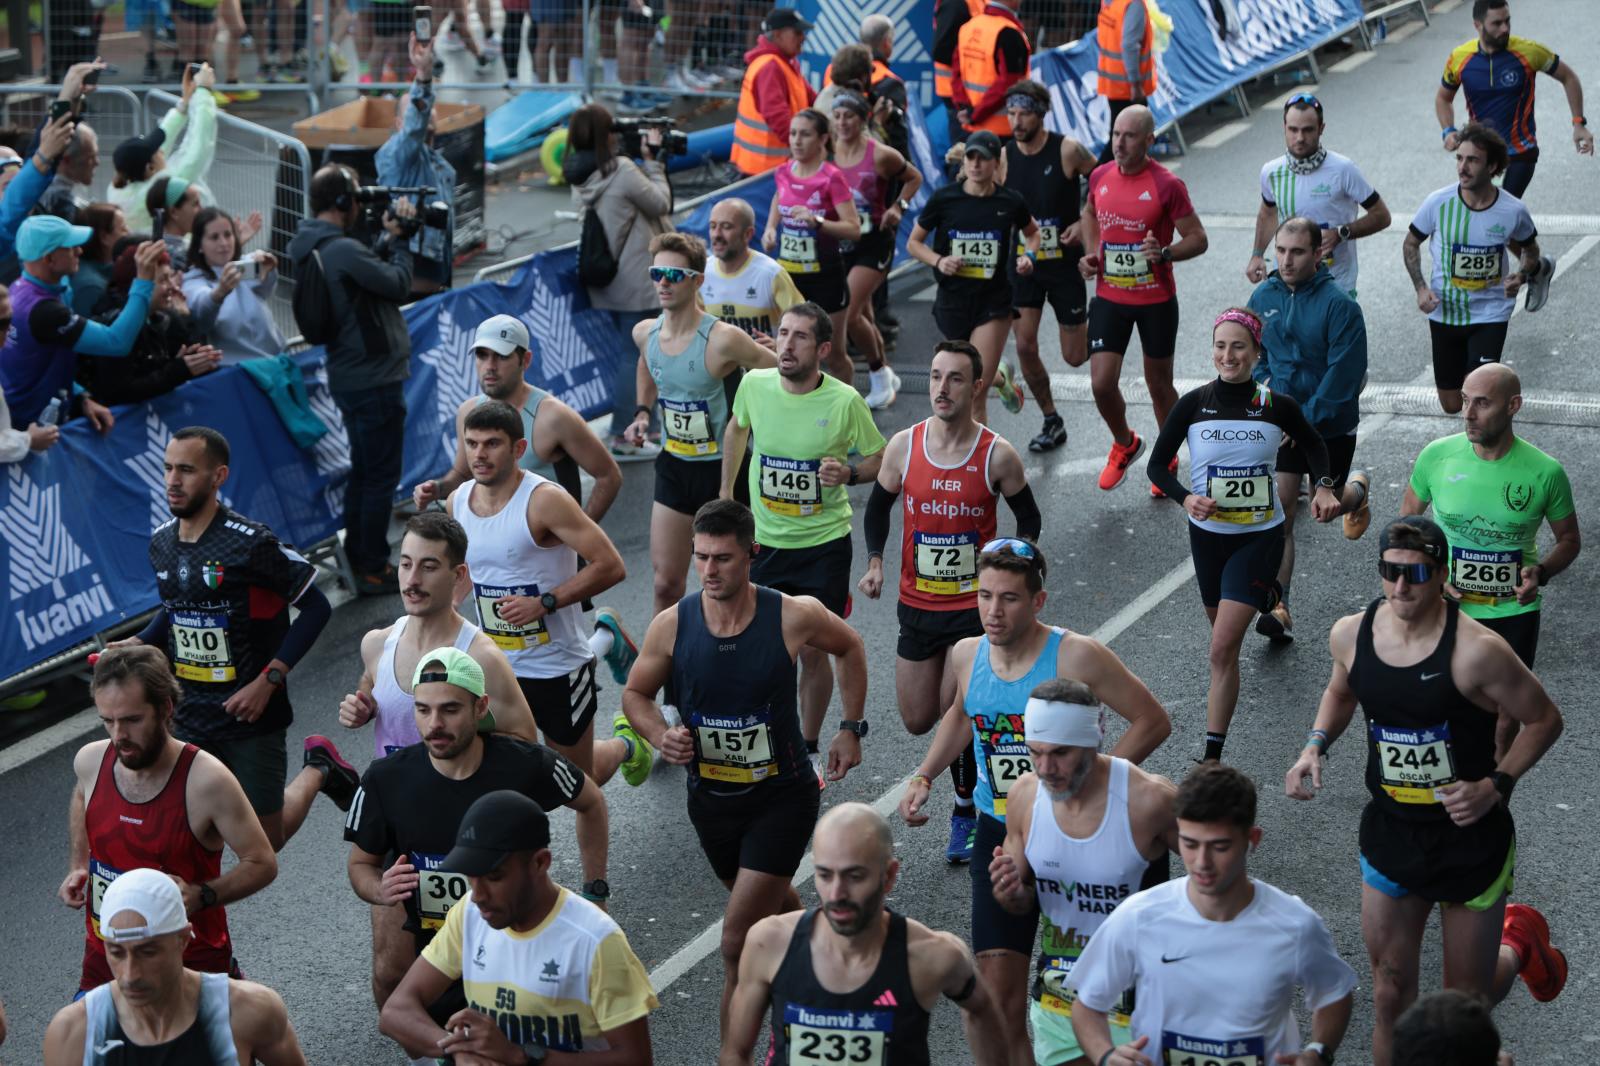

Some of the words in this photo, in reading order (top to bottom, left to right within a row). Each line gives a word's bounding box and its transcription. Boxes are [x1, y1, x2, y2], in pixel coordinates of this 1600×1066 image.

[784, 237, 807, 252] 221
[958, 242, 993, 256] 143
[1114, 253, 1136, 266] 49
[1460, 255, 1495, 270] 285
[722, 304, 735, 315] 59
[674, 413, 692, 431] 57
[1200, 429, 1266, 441] CALCOSA
[766, 457, 797, 469] luanvi
[1217, 467, 1250, 476] luanvi
[768, 471, 810, 491] 146
[931, 479, 962, 492] IKER
[1225, 480, 1255, 498] 20
[921, 500, 984, 520] ekipho
[921, 534, 955, 545] luanvi
[930, 548, 961, 566] 72
[1461, 550, 1498, 562] luanvi
[1462, 563, 1511, 583] 266
[480, 586, 512, 597] luanvi
[1456, 580, 1514, 592] PACOMODEST
[15, 573, 114, 650] luanvi
[174, 614, 202, 627] luanvi
[178, 629, 218, 651] 310
[702, 716, 742, 728] luanvi
[993, 713, 1025, 732] AR
[707, 729, 759, 752] 157
[1381, 728, 1418, 744] luanvi
[995, 744, 1031, 754] luanv
[724, 753, 747, 762] XABI
[1386, 746, 1440, 769] 244
[998, 758, 1033, 780] 28
[97, 861, 121, 881] luan
[428, 875, 467, 900] 30
[1078, 900, 1117, 915] HAR
[496, 987, 516, 1011] 59
[799, 1008, 854, 1028] luanvi
[799, 1031, 872, 1063] 233
[1176, 1035, 1228, 1056] luanvi
